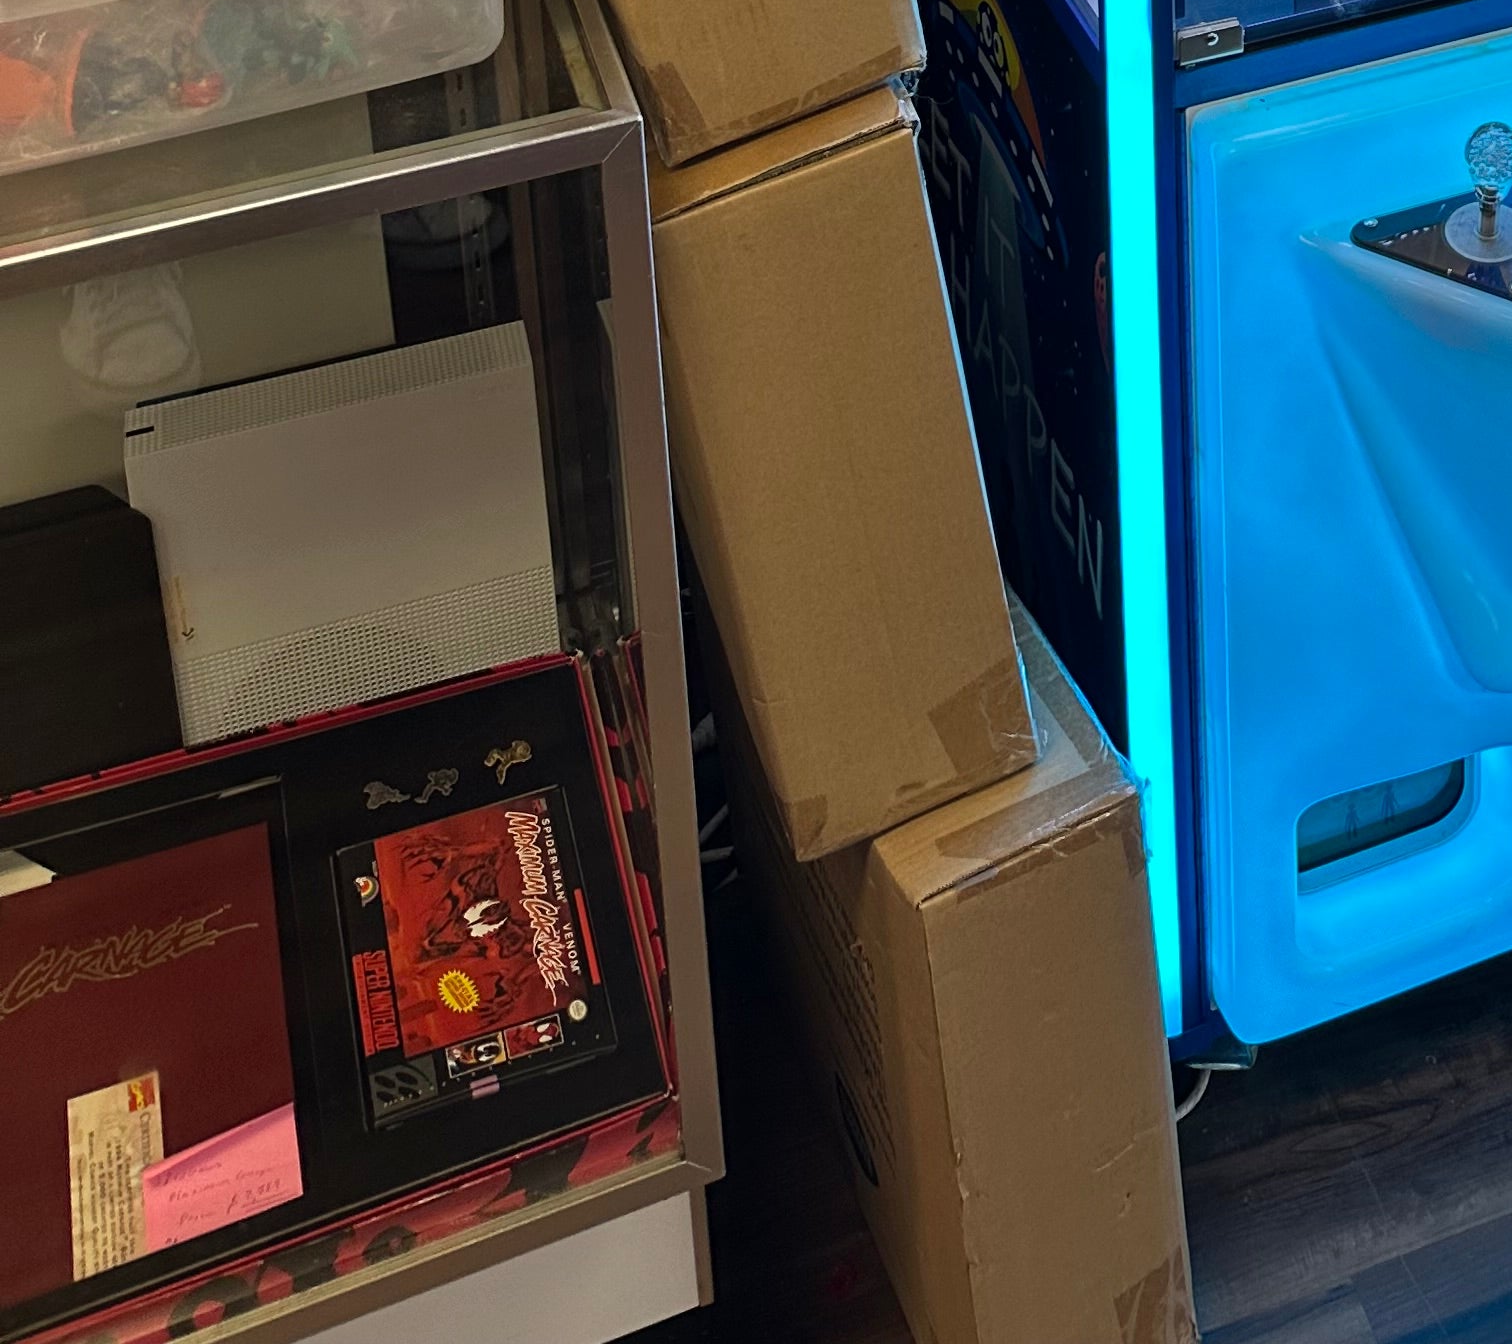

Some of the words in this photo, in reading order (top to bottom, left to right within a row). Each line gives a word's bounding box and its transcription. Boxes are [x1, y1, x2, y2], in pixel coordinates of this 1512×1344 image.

[504, 812, 548, 896] MAXIMUM
[541, 817, 567, 900] SPIDER-MAN
[362, 950, 391, 990] SUPER
[518, 898, 570, 1007] CARNAGE
[562, 922, 581, 973] VENOM
[368, 990, 400, 1051] NINTENDO
